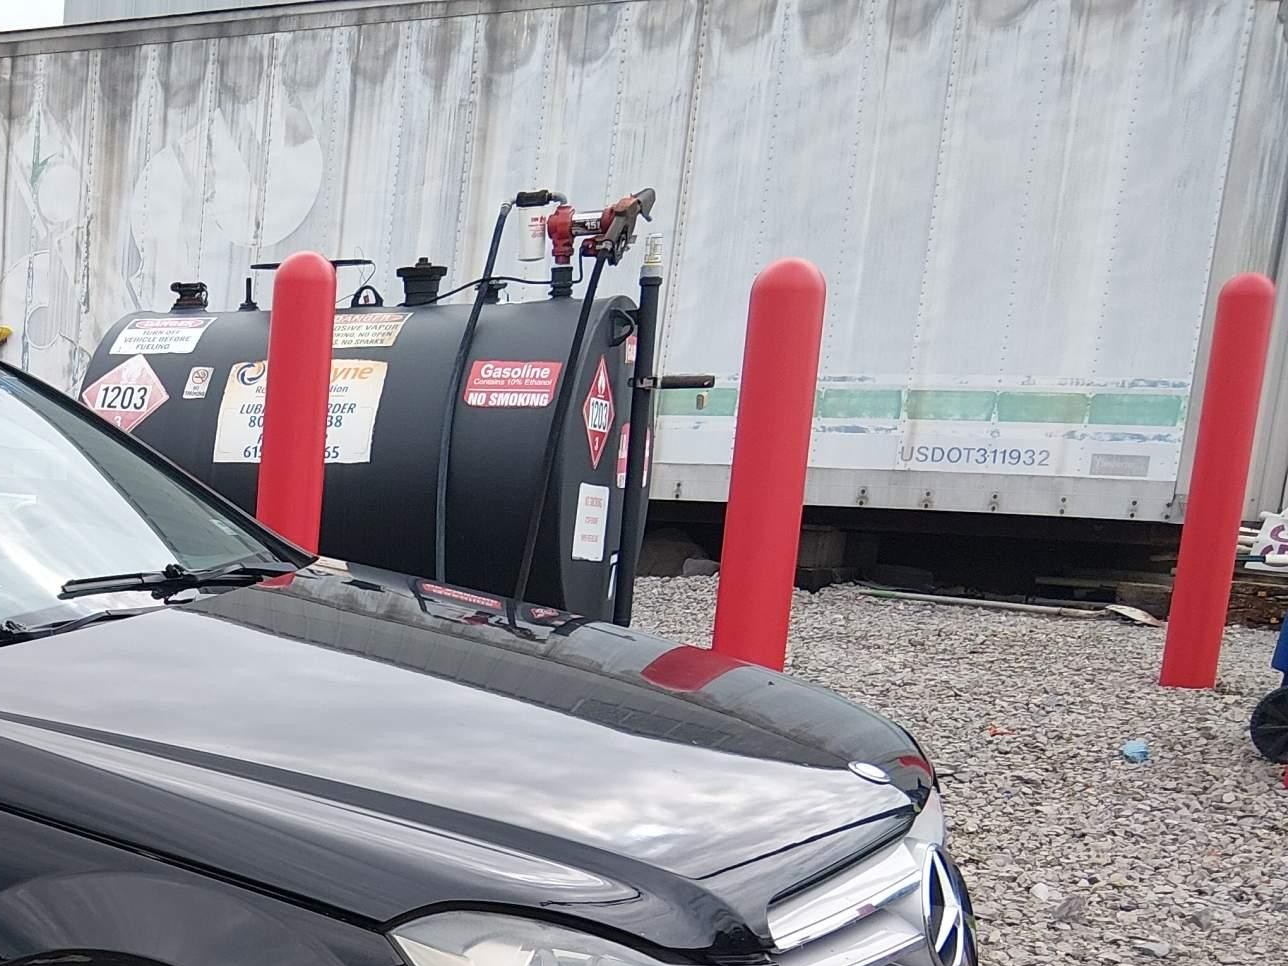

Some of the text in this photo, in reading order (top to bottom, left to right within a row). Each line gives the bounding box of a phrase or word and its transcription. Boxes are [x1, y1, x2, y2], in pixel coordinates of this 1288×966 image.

[334, 325, 363, 333] OSIVE
[334, 332, 355, 341] KING,
[124, 335, 191, 344] VEHICLE BEFORE
[331, 367, 374, 383] yne
[480, 363, 551, 379] Gasoline
[525, 378, 553, 386] Ethanol
[101, 386, 148, 410] 1203
[467, 391, 549, 407] NO SMOKING
[248, 415, 343, 428] 80 38
[590, 400, 609, 431] 1203
[243, 445, 340, 459] 61 65
[900, 446, 1051, 466] USDOT311932
